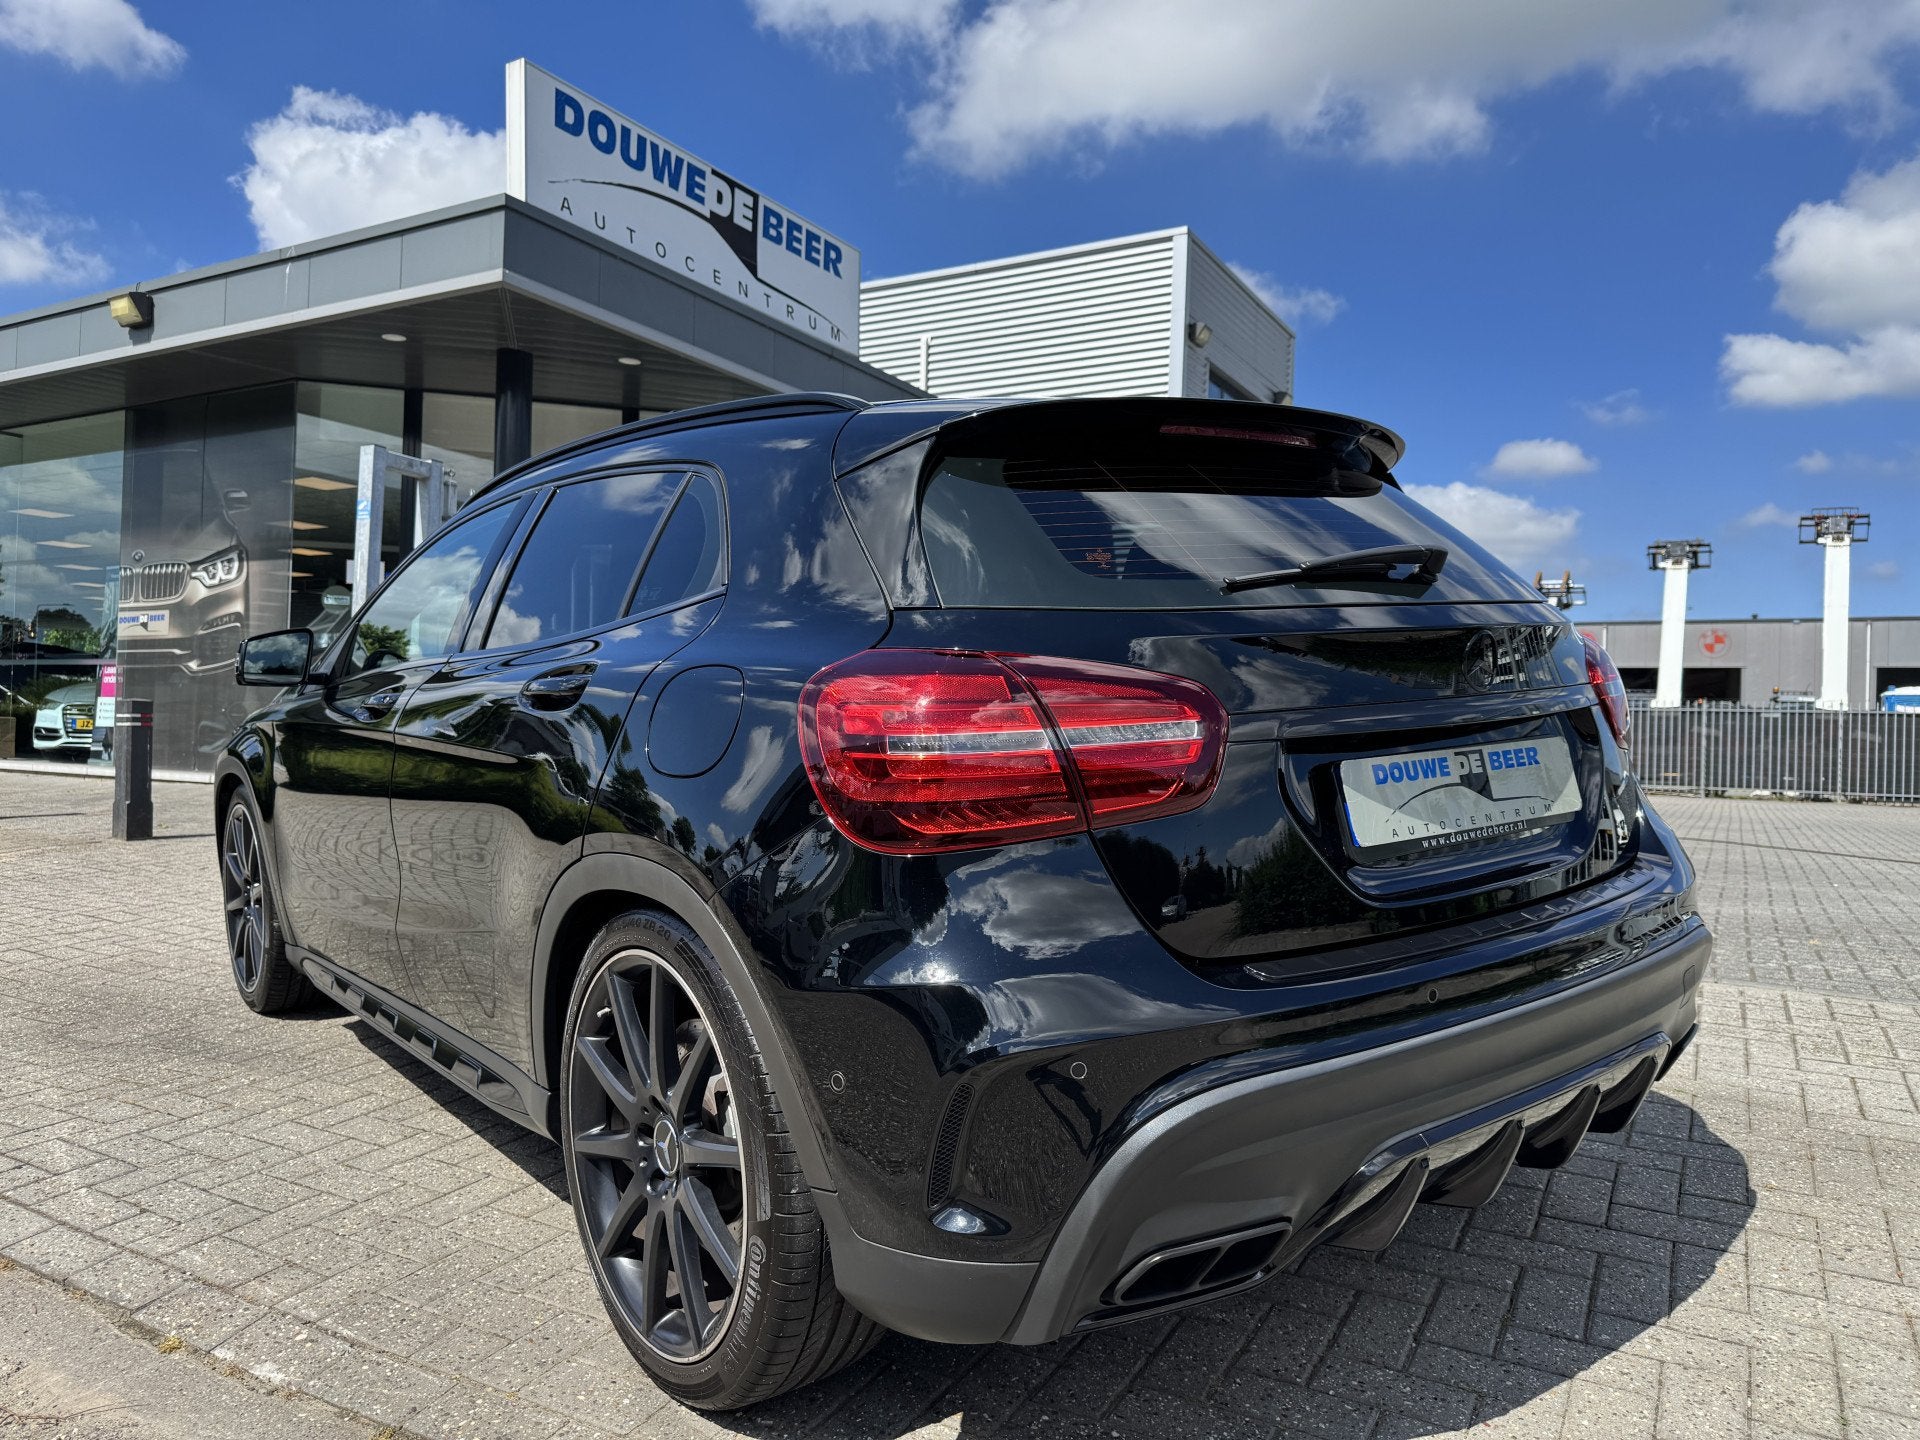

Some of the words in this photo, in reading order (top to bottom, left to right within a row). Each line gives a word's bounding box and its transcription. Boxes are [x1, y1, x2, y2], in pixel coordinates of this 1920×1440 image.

[554, 87, 707, 206] DOUWE
[708, 175, 754, 232] DE
[762, 203, 843, 280] BEER
[560, 196, 841, 343] AUTOCENTRUM
[118, 616, 140, 624] DOUWE
[1371, 756, 1451, 785] DOUWE
[1457, 753, 1483, 776] DE
[1487, 746, 1541, 771] BEER
[1391, 803, 1553, 838] AUTOCENTRUM
[1421, 820, 1528, 848] www.douwedebeer.nl
[657, 925, 671, 941] 20
